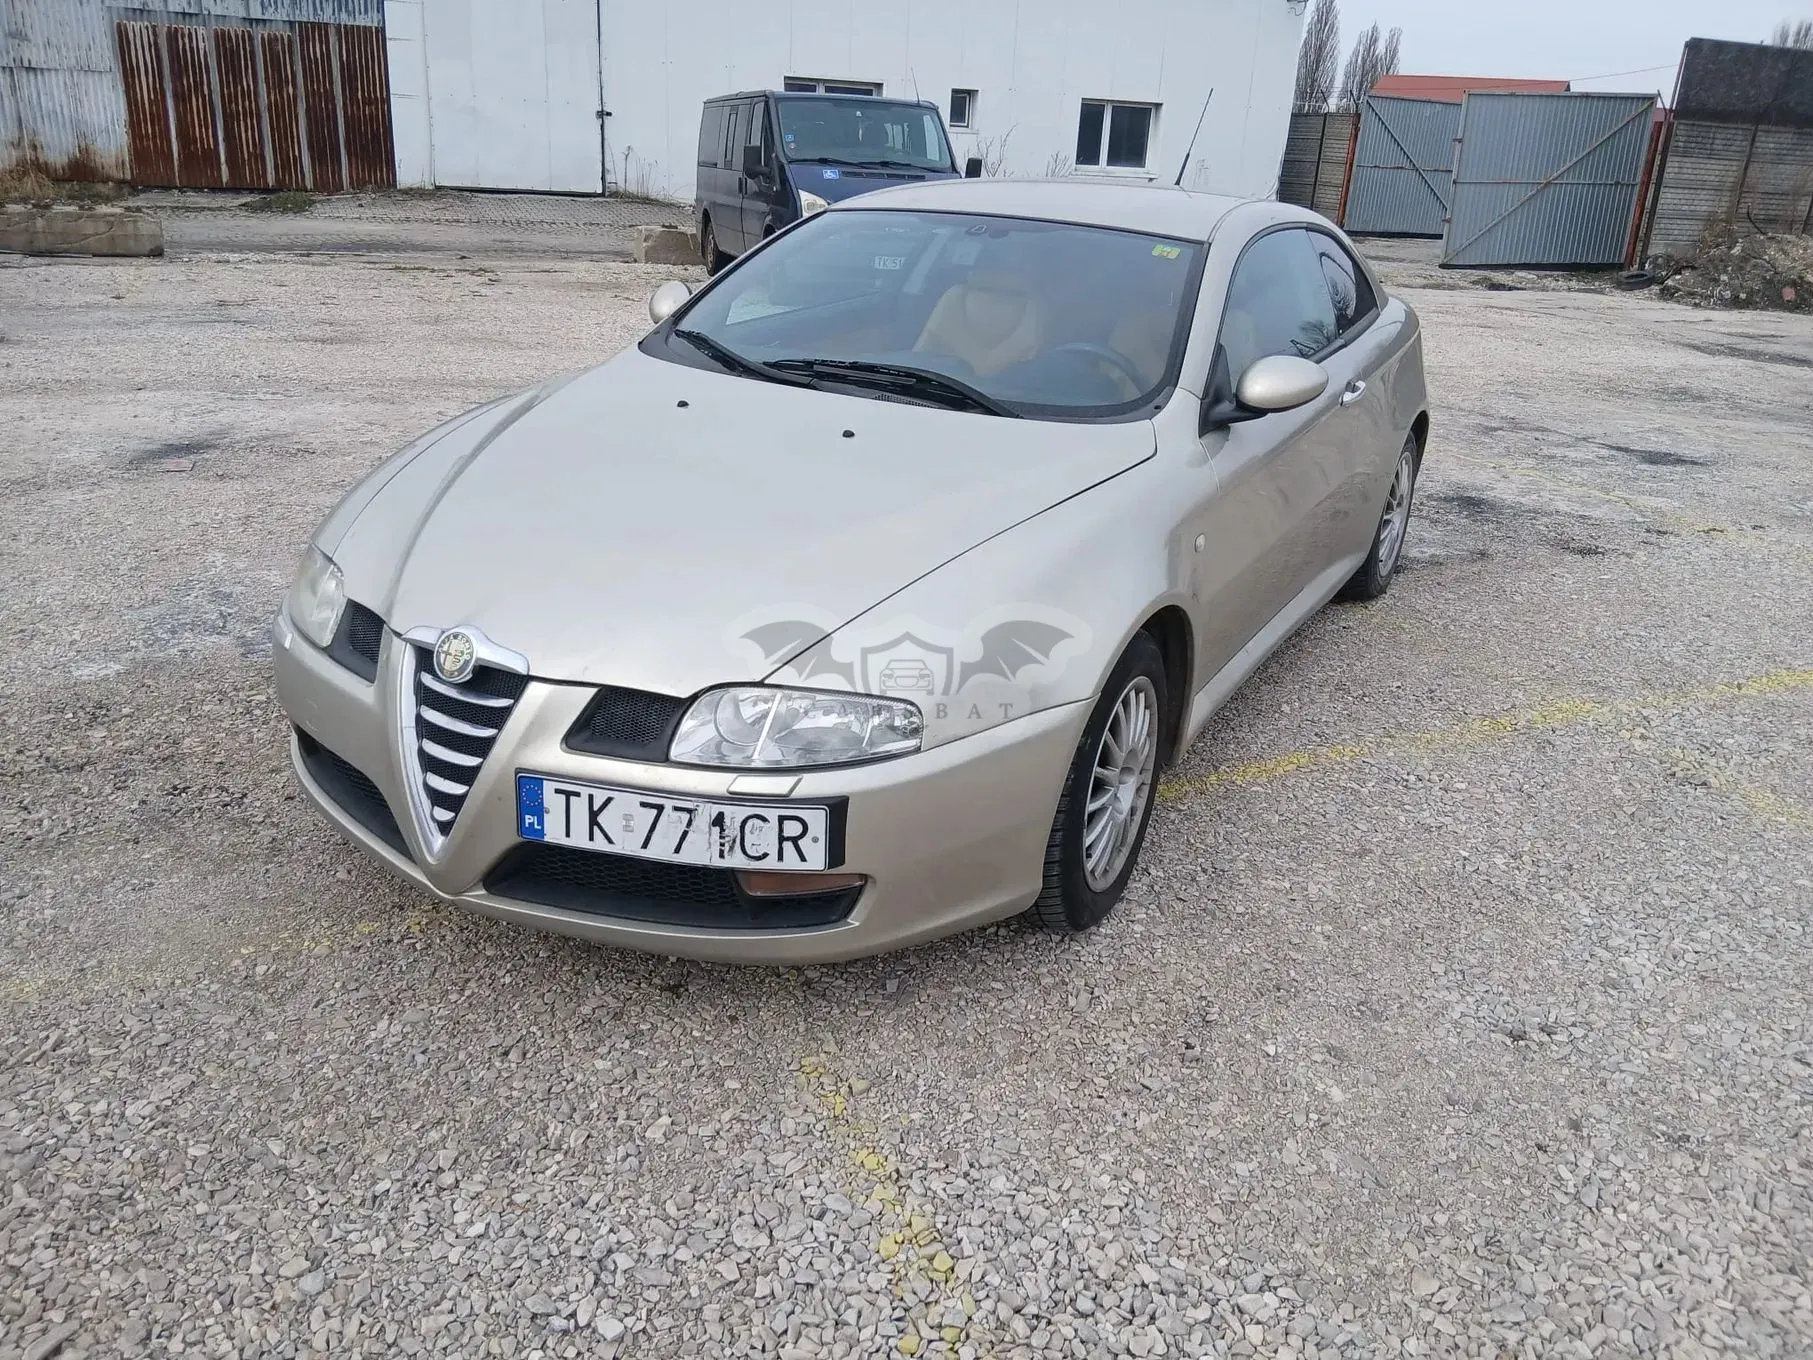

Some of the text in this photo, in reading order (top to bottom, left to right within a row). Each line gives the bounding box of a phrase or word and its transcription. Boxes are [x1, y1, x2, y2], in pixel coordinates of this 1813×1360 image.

[524, 814, 542, 830] PL
[554, 788, 809, 864] TK 771CR
